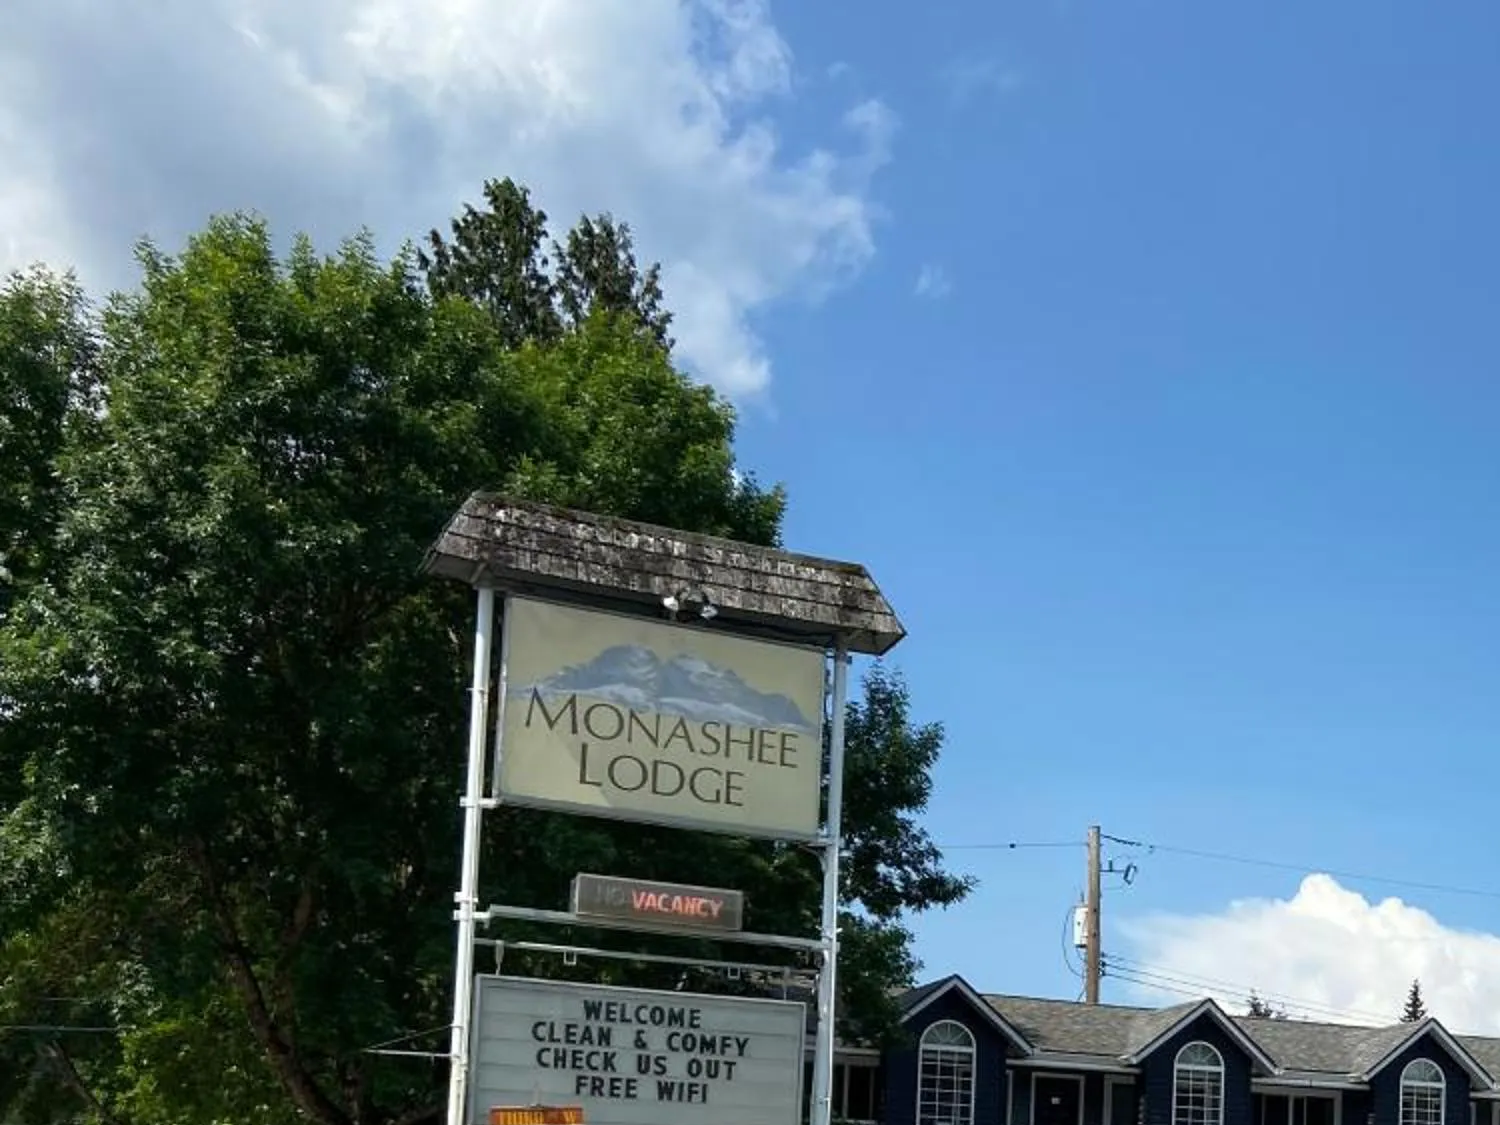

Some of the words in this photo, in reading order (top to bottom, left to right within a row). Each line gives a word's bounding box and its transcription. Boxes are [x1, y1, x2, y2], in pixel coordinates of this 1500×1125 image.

[524, 687, 799, 768] MONASHEE
[579, 743, 745, 806] LODGE
[631, 889, 724, 918] VACANCY
[583, 1000, 702, 1029] WELCOME
[532, 1021, 612, 1047] CLEAN
[633, 1030, 648, 1049] &
[666, 1031, 750, 1057] COMFY
[536, 1047, 617, 1072] CHECK
[636, 1055, 668, 1076] US
[687, 1058, 738, 1081] OUT
[575, 1075, 638, 1099] FREE
[657, 1080, 709, 1104] WIFI
